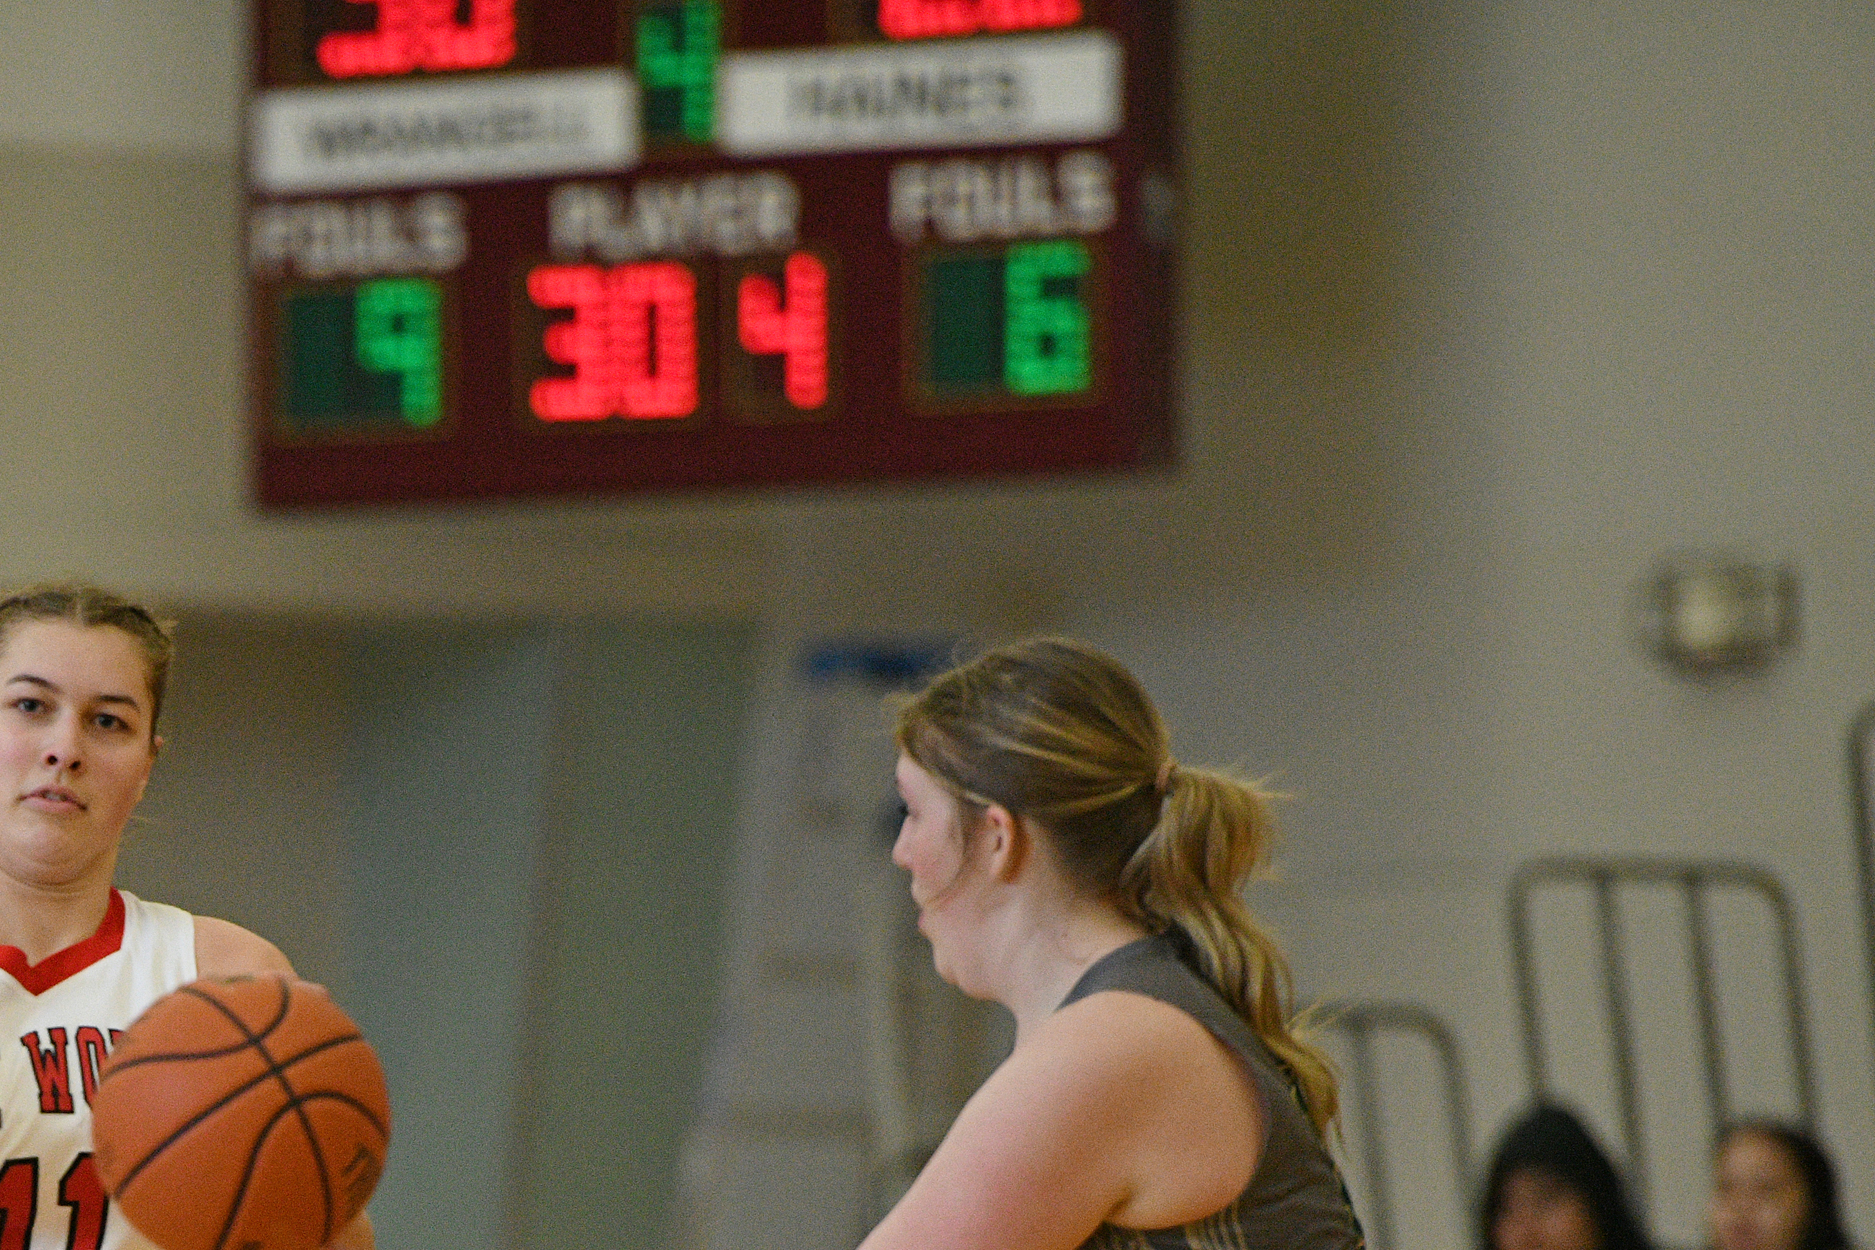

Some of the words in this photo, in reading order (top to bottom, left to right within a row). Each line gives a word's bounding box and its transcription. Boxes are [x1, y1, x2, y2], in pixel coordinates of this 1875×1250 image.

[247, 196, 467, 276] FOULS
[547, 172, 799, 256] PLAYER
[887, 152, 1115, 244] FOULS
[354, 277, 444, 427] 9
[527, 262, 697, 421] 30
[738, 251, 827, 410] 4
[1005, 241, 1091, 395] 6
[20, 1026, 125, 1114] WO
